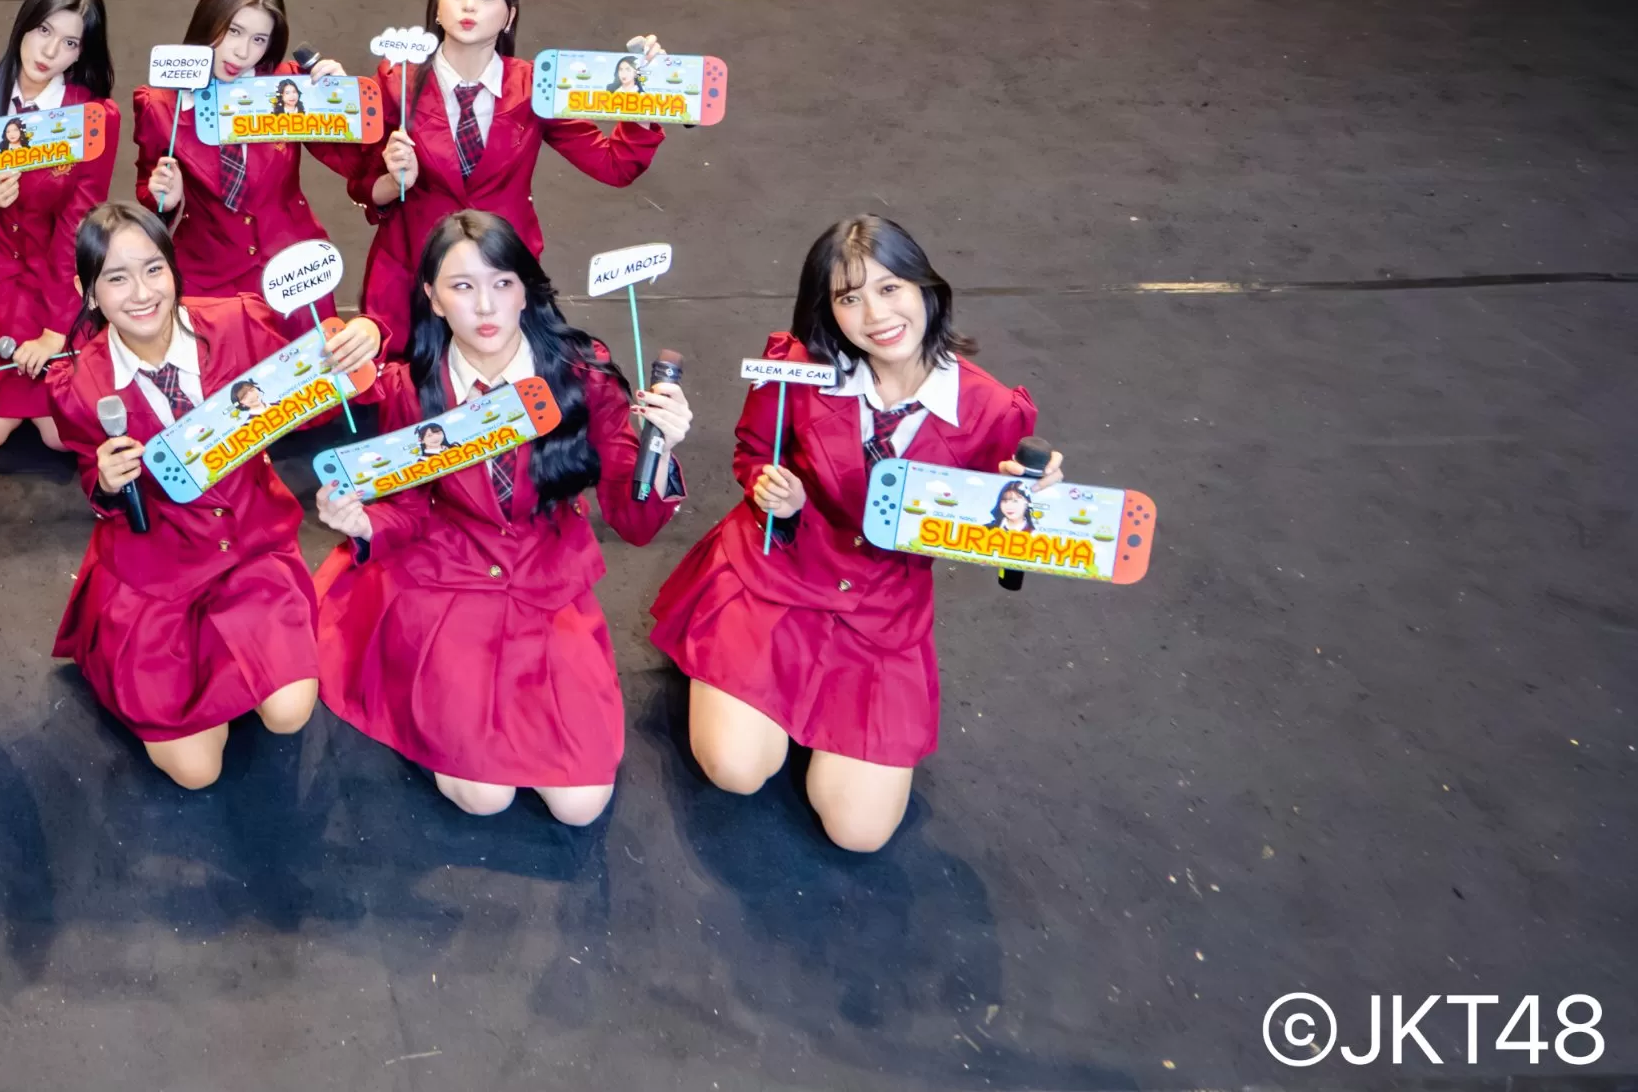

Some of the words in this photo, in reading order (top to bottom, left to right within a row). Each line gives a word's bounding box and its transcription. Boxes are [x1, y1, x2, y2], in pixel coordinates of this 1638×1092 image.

[378, 39, 404, 51] KEREN
[152, 58, 209, 68] SUROBOYO
[160, 69, 202, 79] AZEEEK!
[567, 90, 687, 117] SURABAYA
[232, 113, 349, 136] SURABAYA
[268, 254, 336, 290] SUWANGAR
[593, 268, 620, 285] AKU
[624, 252, 668, 275] MBOIS
[282, 269, 332, 299] REEKKK!!!
[745, 365, 783, 376] KALEM
[787, 368, 802, 377] AE
[806, 369, 832, 380] CAK!
[201, 377, 339, 473] SURABAYA
[372, 425, 520, 493] SURABAYA
[919, 517, 1095, 568] SURABAYA
